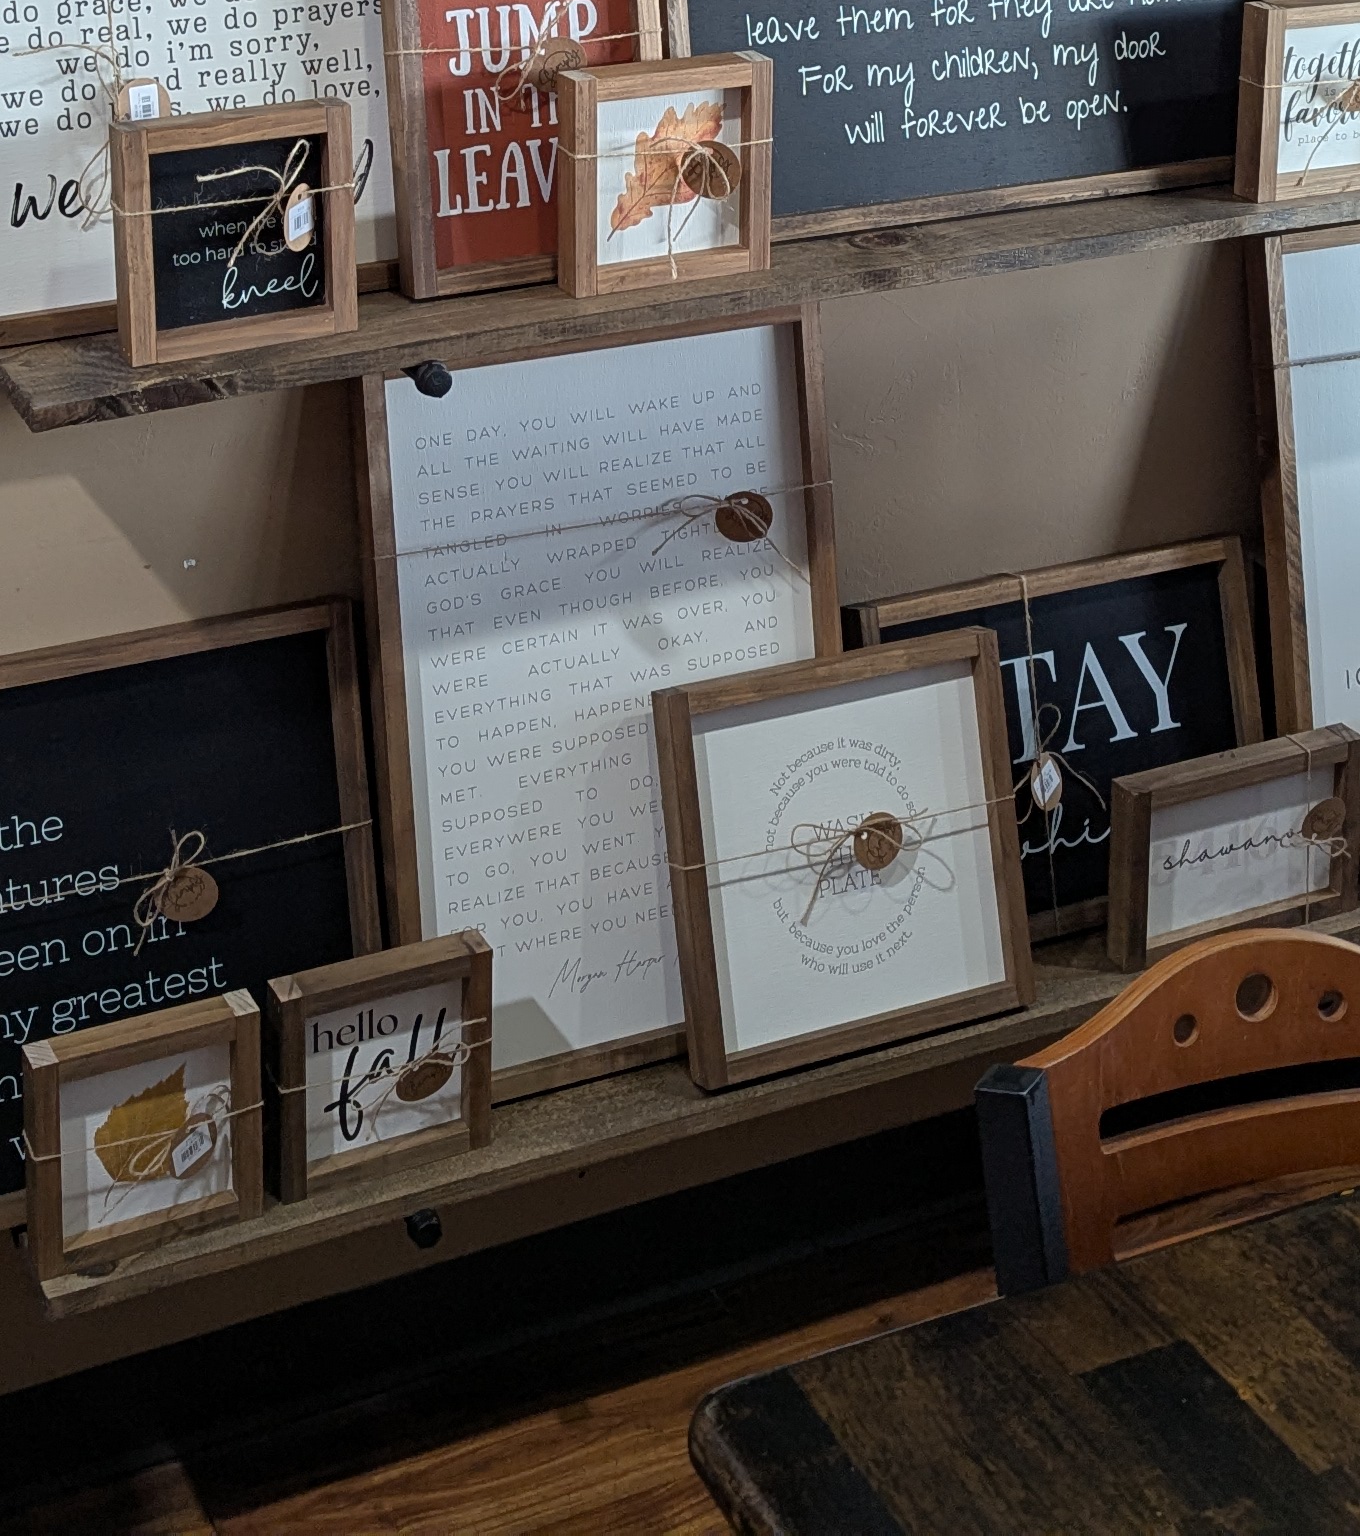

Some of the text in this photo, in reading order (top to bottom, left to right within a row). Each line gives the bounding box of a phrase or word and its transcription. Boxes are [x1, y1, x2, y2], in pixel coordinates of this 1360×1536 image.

[463, 88, 501, 134] IN
[1298, 130, 1331, 147] place
[1335, 130, 1348, 142] to
[434, 137, 558, 217] LEAV
[173, 253, 200, 266] too
[223, 254, 317, 309] kneel
[416, 433, 451, 449] ONE
[519, 417, 555, 432] YOU
[570, 408, 615, 423] WILL
[628, 396, 678, 414] WAKE
[693, 391, 714, 404] UP
[728, 383, 761, 399] AND
[434, 642, 779, 723] EVERYTHING THAT WAS SUPPOSED
[1000, 623, 1188, 764] TAY
[770, 737, 901, 796] Not because it was dirty,
[819, 868, 882, 898] PLATE
[51, 956, 227, 1035] greatest
[313, 1009, 398, 1053] hello
[324, 1008, 448, 1142] fall
